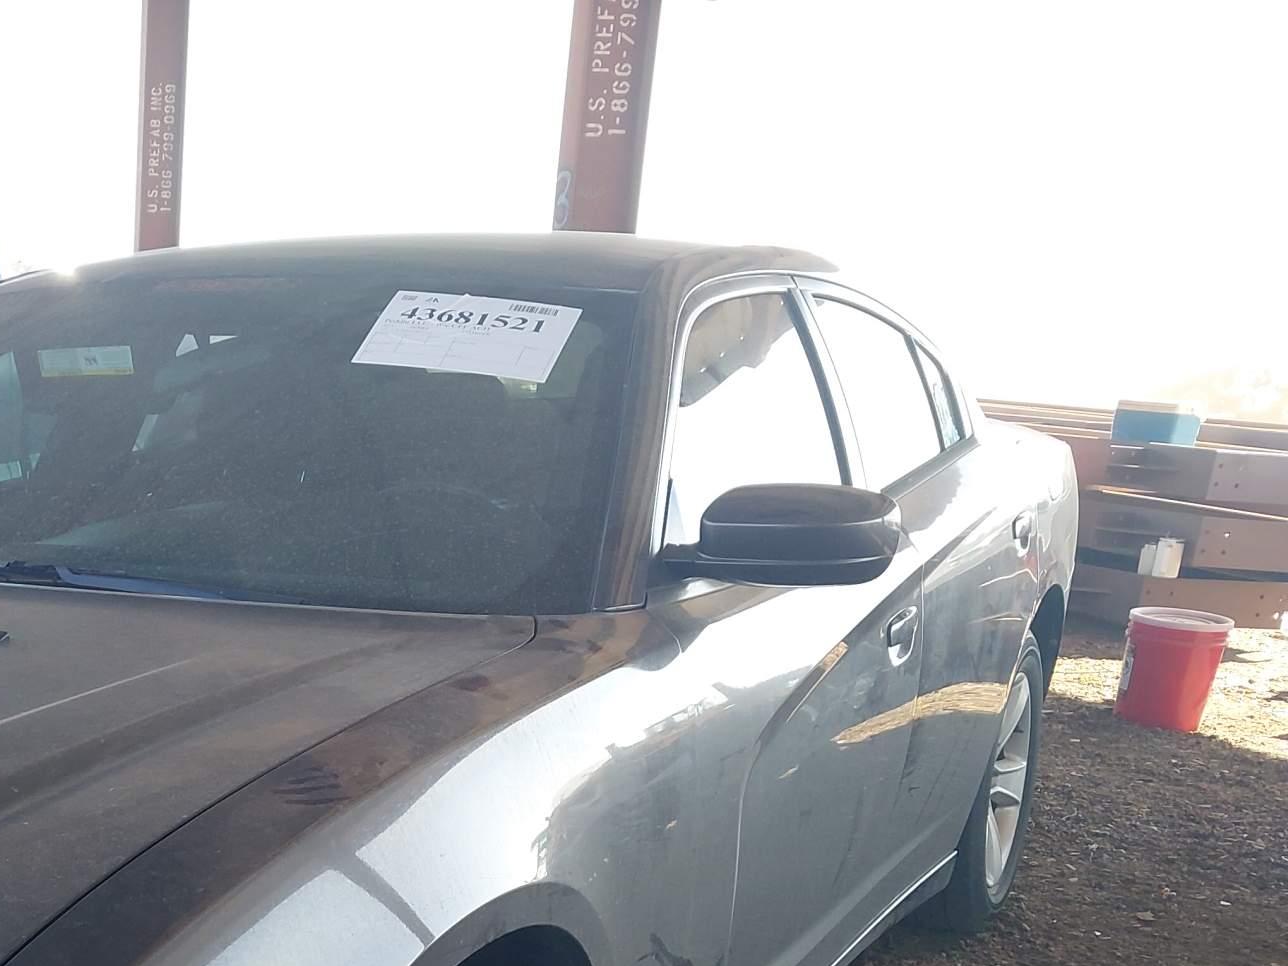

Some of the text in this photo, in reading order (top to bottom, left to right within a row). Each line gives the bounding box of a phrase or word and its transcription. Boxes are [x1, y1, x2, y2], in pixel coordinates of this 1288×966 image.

[585, 0, 615, 137] U.S. PREF
[147, 82, 163, 214] U.S. PREFAB INC.
[400, 306, 545, 334] 43681521
